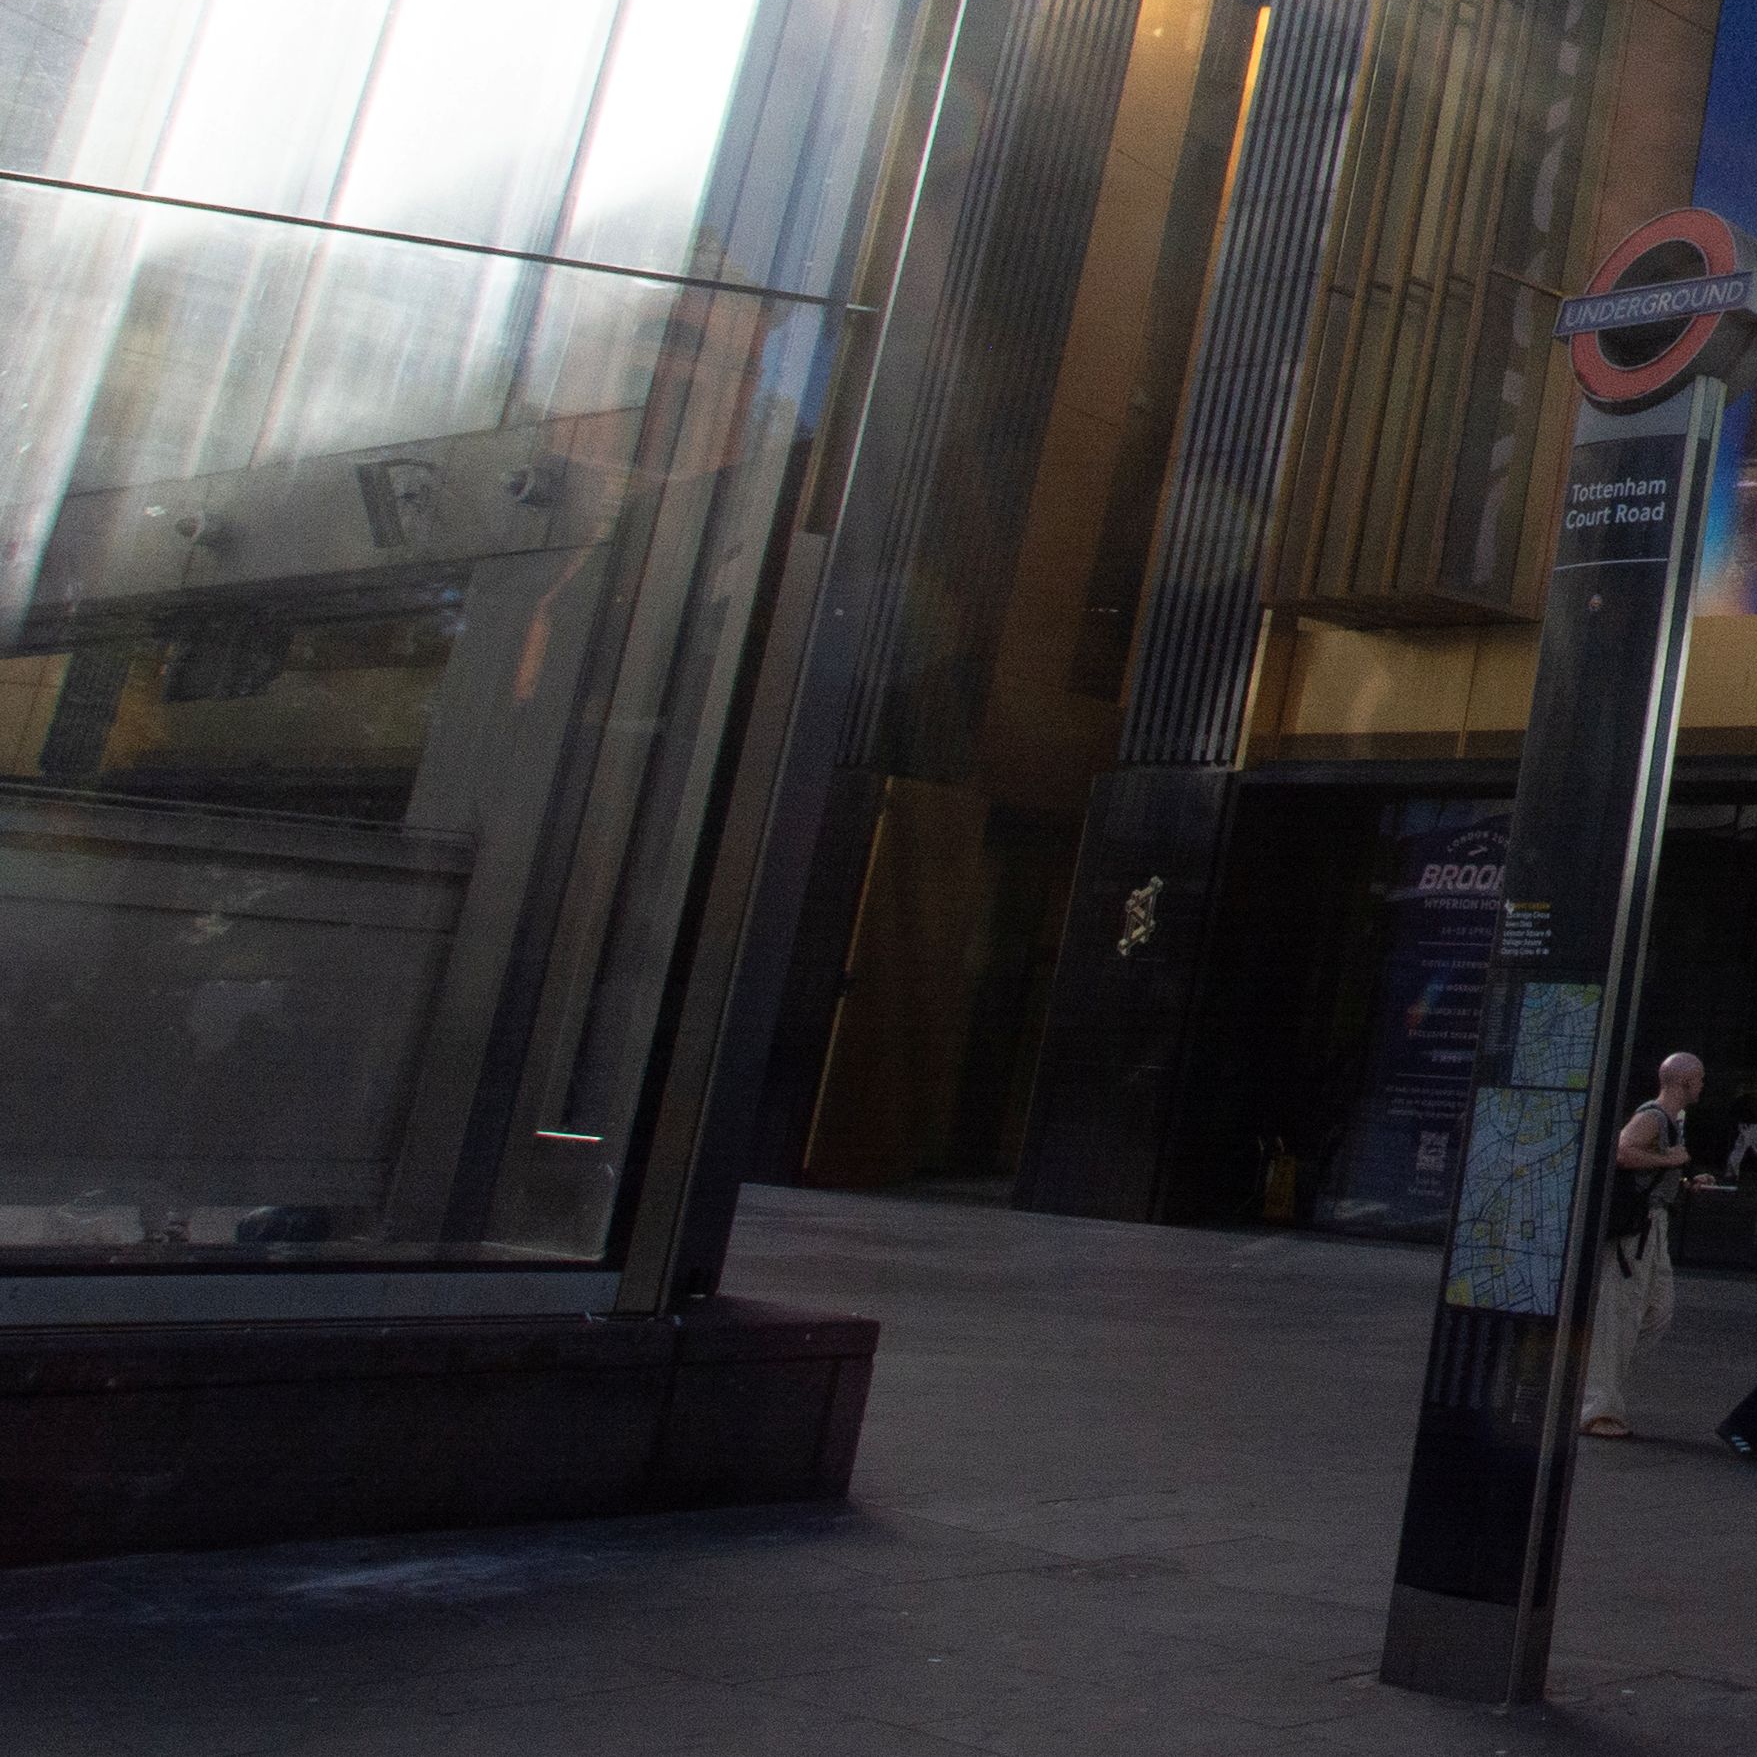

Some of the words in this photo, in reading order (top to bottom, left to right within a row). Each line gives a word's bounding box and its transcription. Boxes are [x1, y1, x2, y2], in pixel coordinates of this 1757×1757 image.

[1565, 280, 1745, 328] UNDERGROUND
[1571, 476, 1667, 504] Tottenham
[1565, 504, 1611, 529] Court
[1615, 502, 1665, 524] Road
[1418, 864, 1506, 890] BROO
